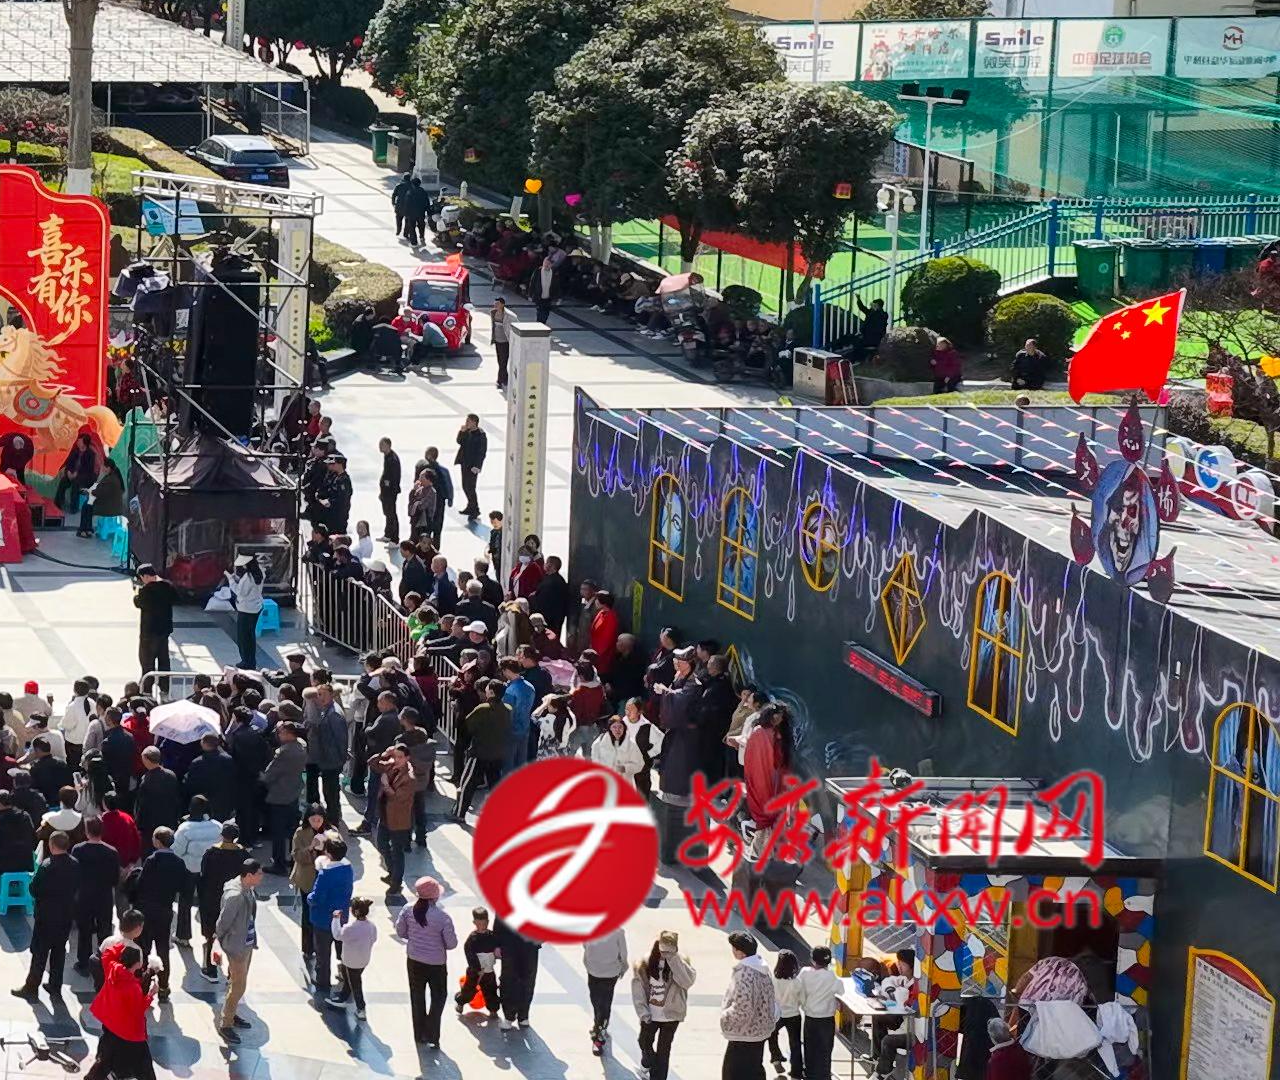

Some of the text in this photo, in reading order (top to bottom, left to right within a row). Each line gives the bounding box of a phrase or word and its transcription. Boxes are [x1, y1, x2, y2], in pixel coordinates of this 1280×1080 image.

[985, 28, 1044, 46] Smile
[782, 59, 831, 73] 笑口腔
[27, 214, 94, 345] 喜乐有你
